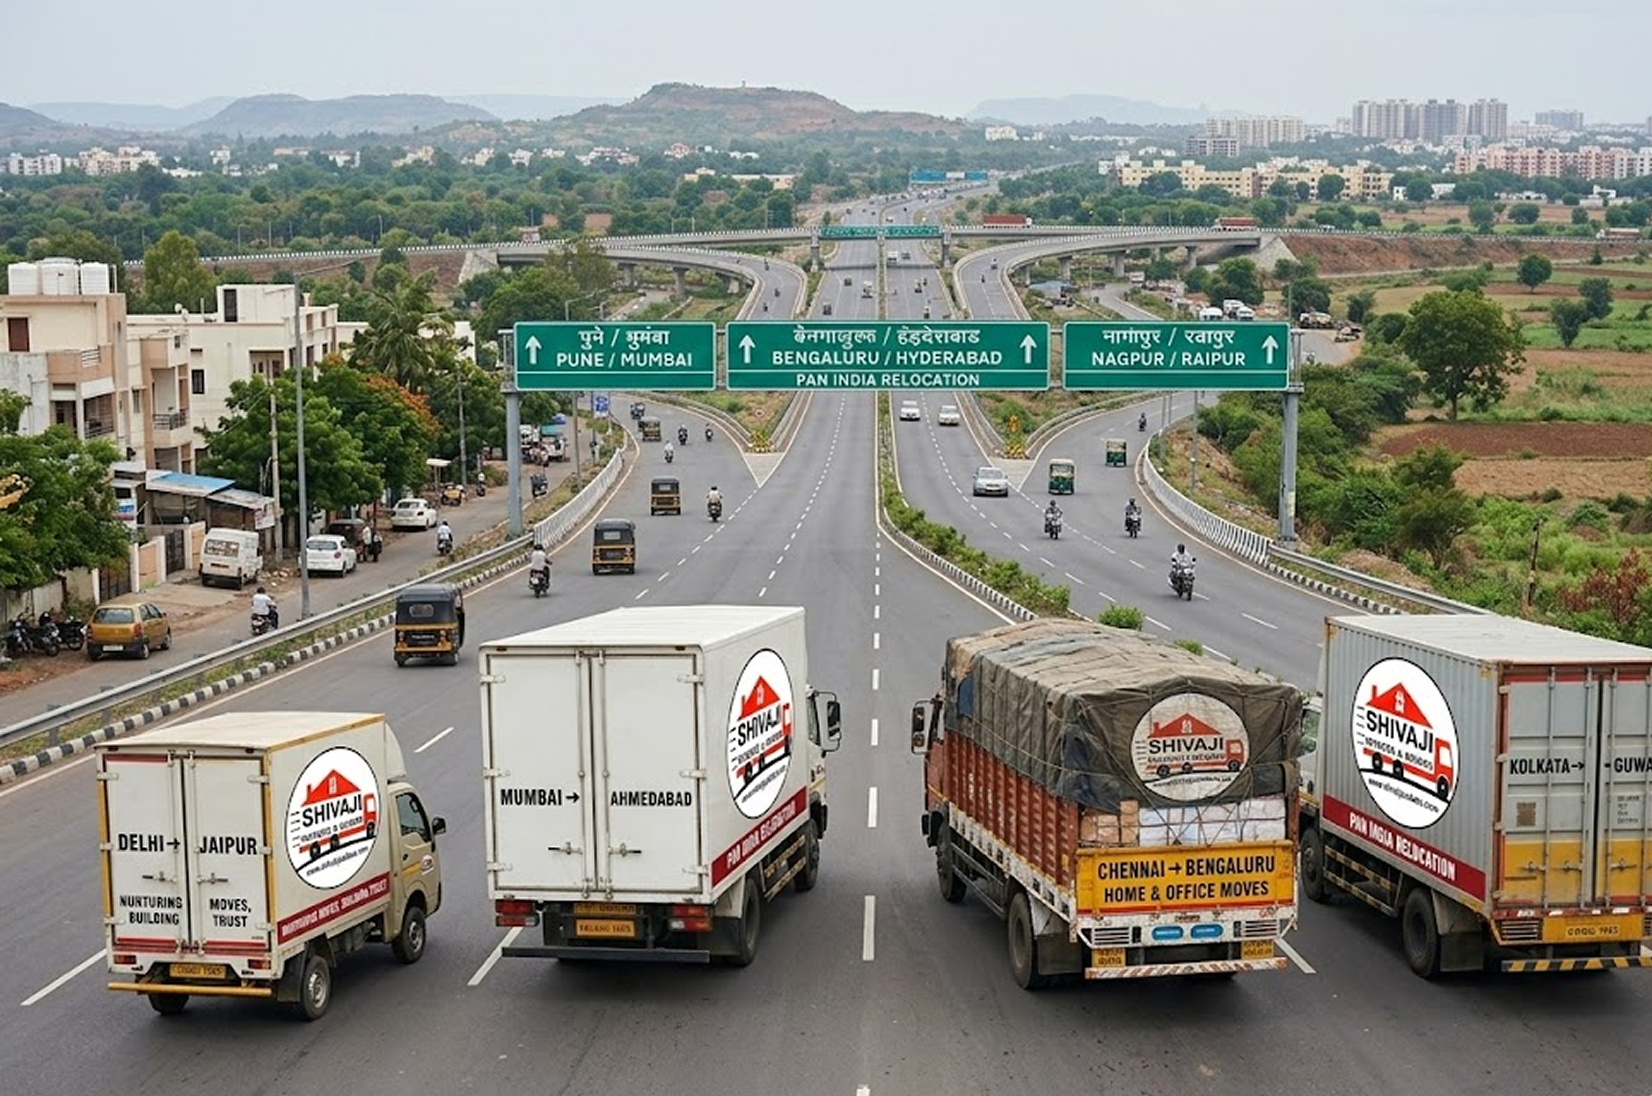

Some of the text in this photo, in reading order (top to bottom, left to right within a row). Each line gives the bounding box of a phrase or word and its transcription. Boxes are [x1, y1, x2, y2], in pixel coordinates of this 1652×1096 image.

[610, 328, 620, 347] /
[882, 326, 891, 346] /
[1168, 327, 1177, 346] /
[556, 352, 692, 368] PUNE / MUMBAI
[772, 351, 1002, 366] BENGALURU / HYDERABAD
[1092, 351, 1246, 367] NAGPUR / RAIPUR
[797, 374, 980, 386] PAN INDIA RELOCATION
[1366, 710, 1434, 754] SHIVAJI
[1149, 737, 1223, 755] SHIVAJI
[1509, 758, 1571, 775] KOLKATA
[500, 788, 692, 807] MUMBAI AHMEDABAD
[302, 794, 362, 828] SHIVAJI
[118, 833, 257, 855] DELHI JAIPUR
[1098, 855, 1275, 880] CHENNAI BENGALURU
[1104, 881, 1269, 903] HOME & OFFICE MOVES
[209, 898, 252, 913] MOVES,
[212, 915, 248, 927] TRUST
